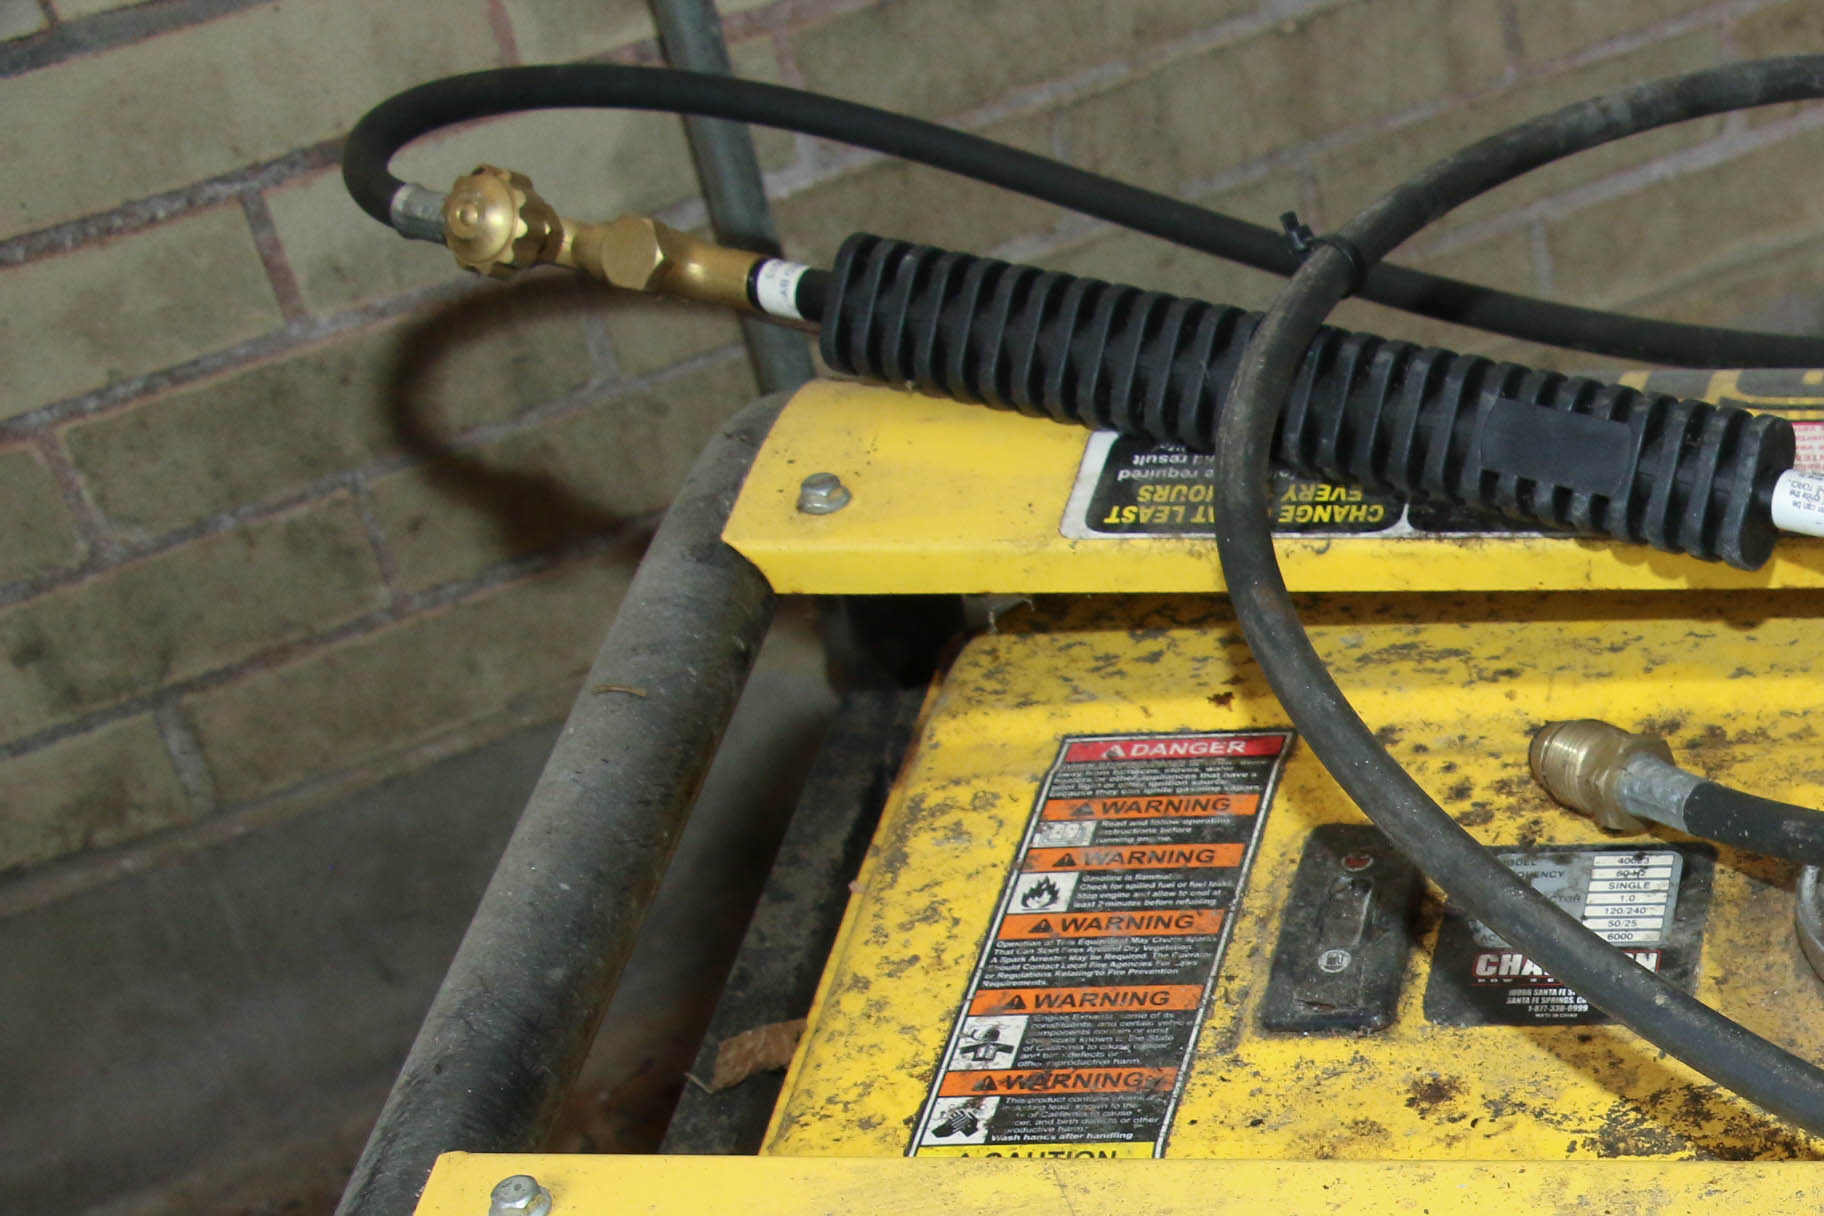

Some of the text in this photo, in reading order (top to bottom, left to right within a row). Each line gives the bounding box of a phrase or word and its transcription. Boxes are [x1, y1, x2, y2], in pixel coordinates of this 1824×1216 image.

[1284, 484, 1361, 501] EVERY
[1104, 505, 1186, 522] LEAST
[1278, 504, 1384, 522] CHANGE
[1130, 741, 1247, 756] DANGER
[1101, 797, 1231, 814] WARNING
[1083, 849, 1216, 865] WARNING
[1608, 881, 1650, 890] SINGLE
[1060, 916, 1194, 932] WARNING
[1607, 932, 1634, 941] 6000
[1022, 959, 1152, 971] Contact Agencies
[1068, 954, 1086, 962] May
[996, 967, 1178, 980] Regulations Prevention
[1033, 991, 1169, 1008] WARNING
[1004, 1071, 1146, 1090] WARNING
[992, 1131, 1133, 1142] Wash after handling
